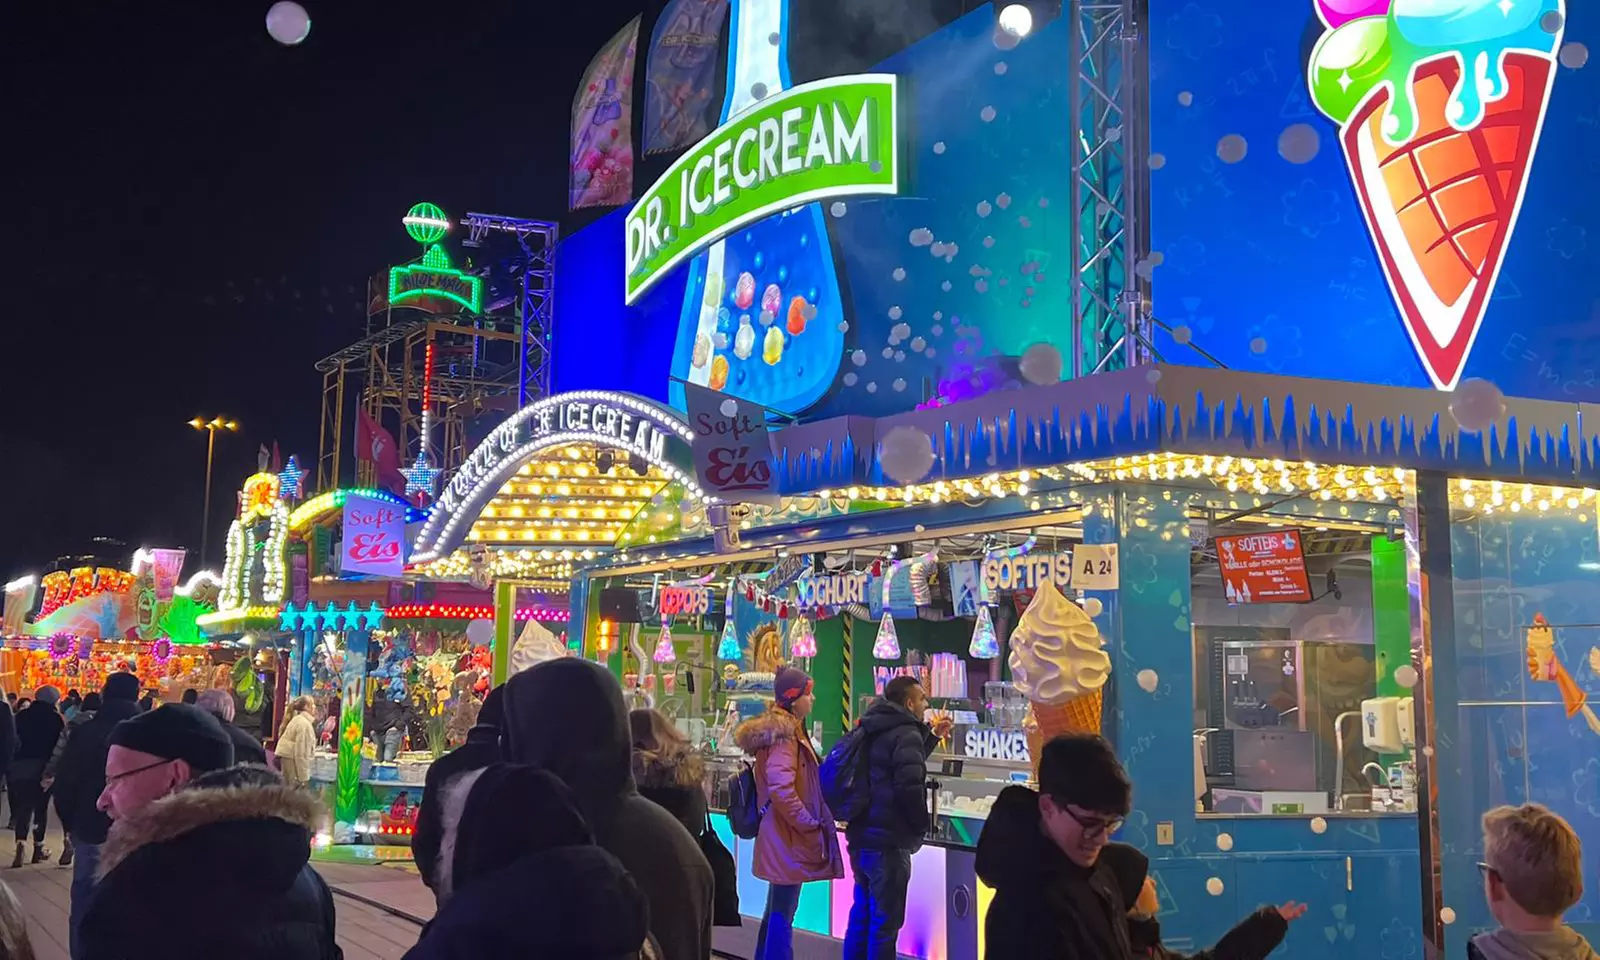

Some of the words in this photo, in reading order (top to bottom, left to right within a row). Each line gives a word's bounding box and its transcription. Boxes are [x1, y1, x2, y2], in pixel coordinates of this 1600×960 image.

[628, 195, 673, 276] DR.
[679, 97, 873, 229] ICECREAM
[441, 440, 492, 512] WORLD
[500, 422, 518, 453] OF
[559, 402, 665, 462] ICECREAM
[705, 446, 770, 486] Eis
[349, 532, 399, 560] Eis
[1237, 535, 1279, 552] SOFTEIS
[986, 552, 1071, 590] SOFTEIS
[1083, 559, 1094, 574] A
[1099, 559, 1112, 575] 24
[659, 586, 709, 614] ICEPOPS
